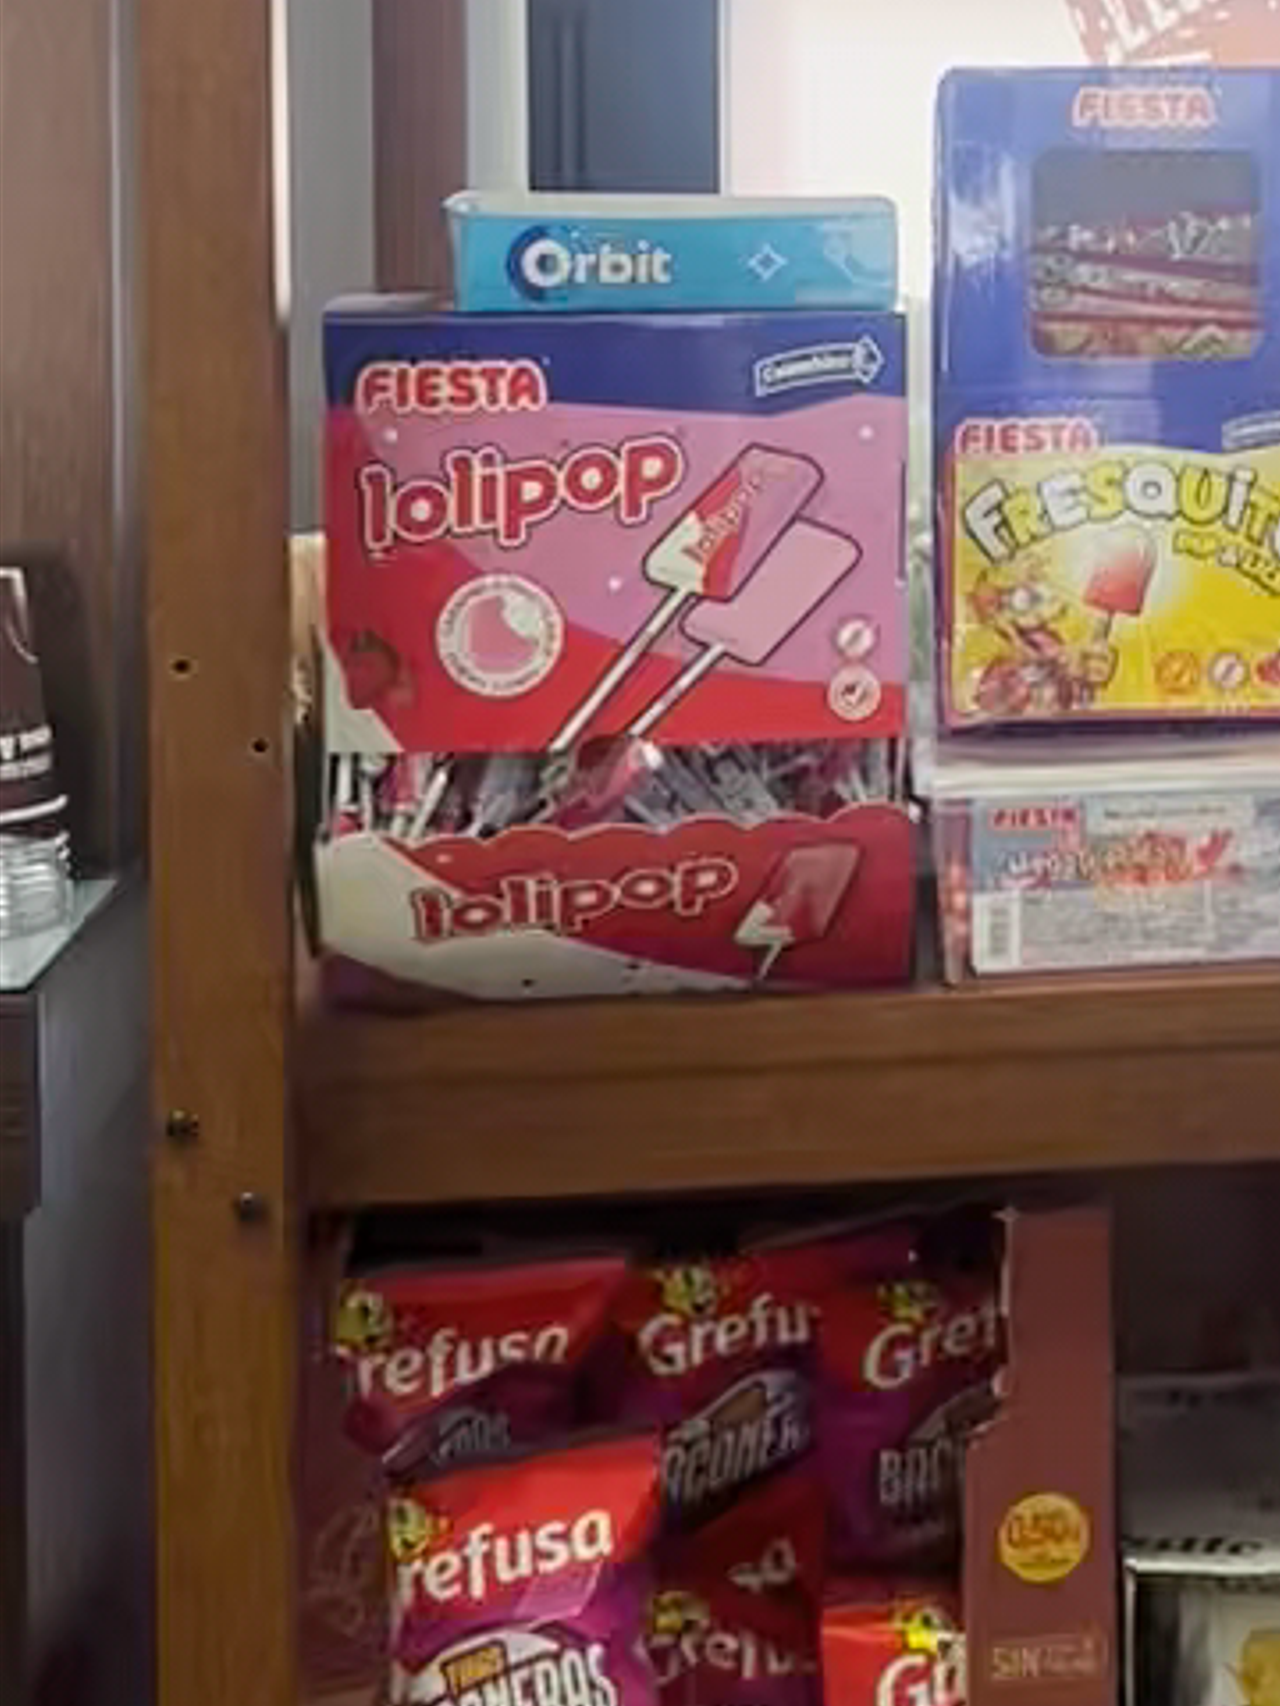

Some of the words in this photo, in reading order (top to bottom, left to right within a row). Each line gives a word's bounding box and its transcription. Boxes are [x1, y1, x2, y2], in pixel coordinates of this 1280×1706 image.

[1072, 86, 1216, 128] FIESTA
[522, 236, 673, 288] Orbit
[356, 360, 548, 416] FIESTA
[955, 417, 1097, 456] FIESTA
[359, 434, 685, 552] lolipop
[411, 855, 739, 945] lolipop
[638, 1292, 812, 1376] Grefu
[863, 1304, 1000, 1390] Gref
[397, 1509, 615, 1603] refusa
